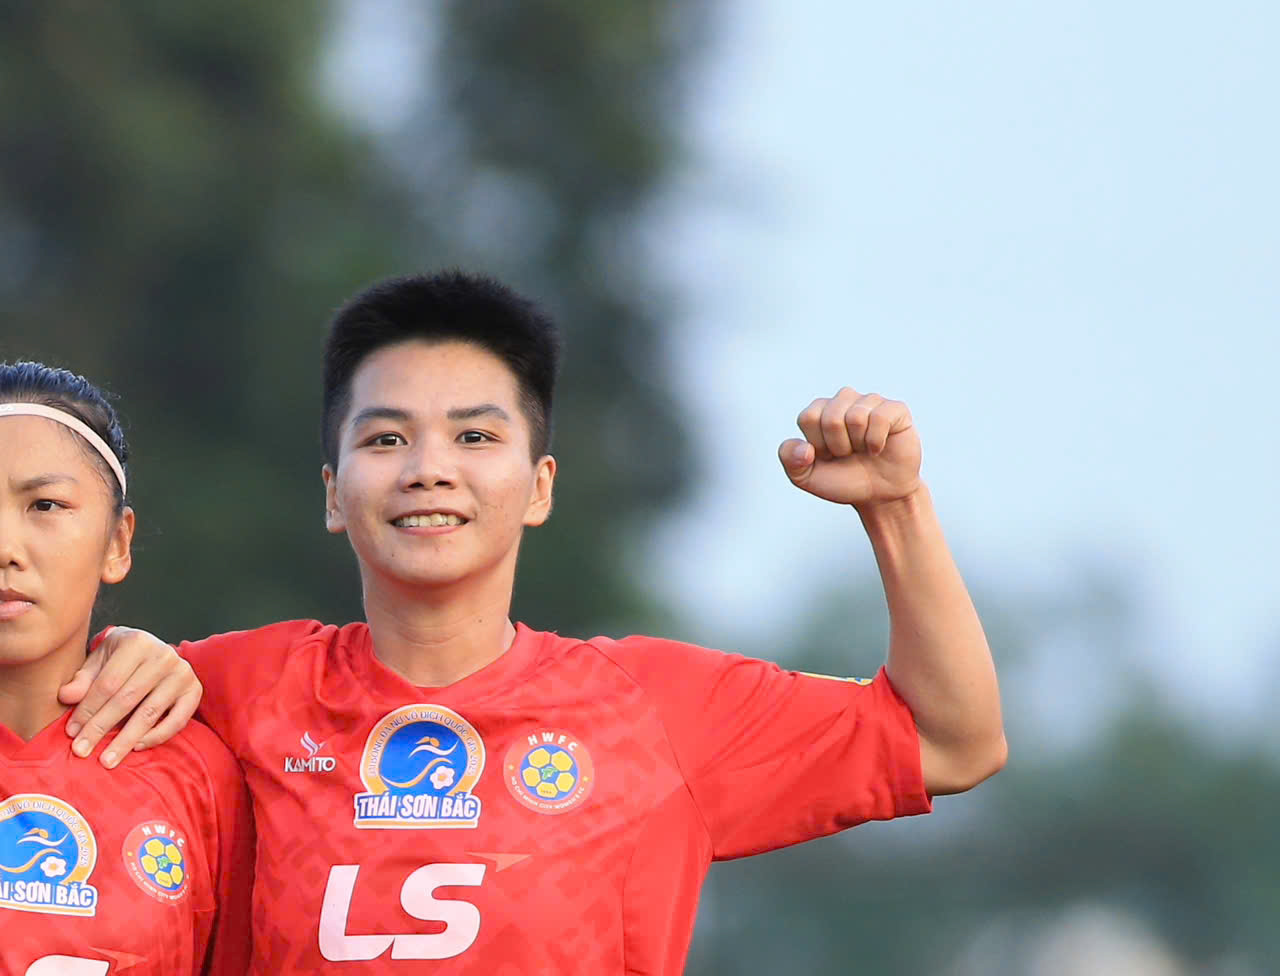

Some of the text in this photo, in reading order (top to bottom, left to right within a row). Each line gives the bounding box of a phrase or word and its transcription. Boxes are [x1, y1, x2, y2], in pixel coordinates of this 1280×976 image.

[284, 756, 337, 773] KAMITO
[359, 792, 477, 818] THÁI SƠN BẮC
[14, 880, 51, 904] SƠN
[56, 882, 93, 907] BẮC
[318, 863, 487, 961] LS
